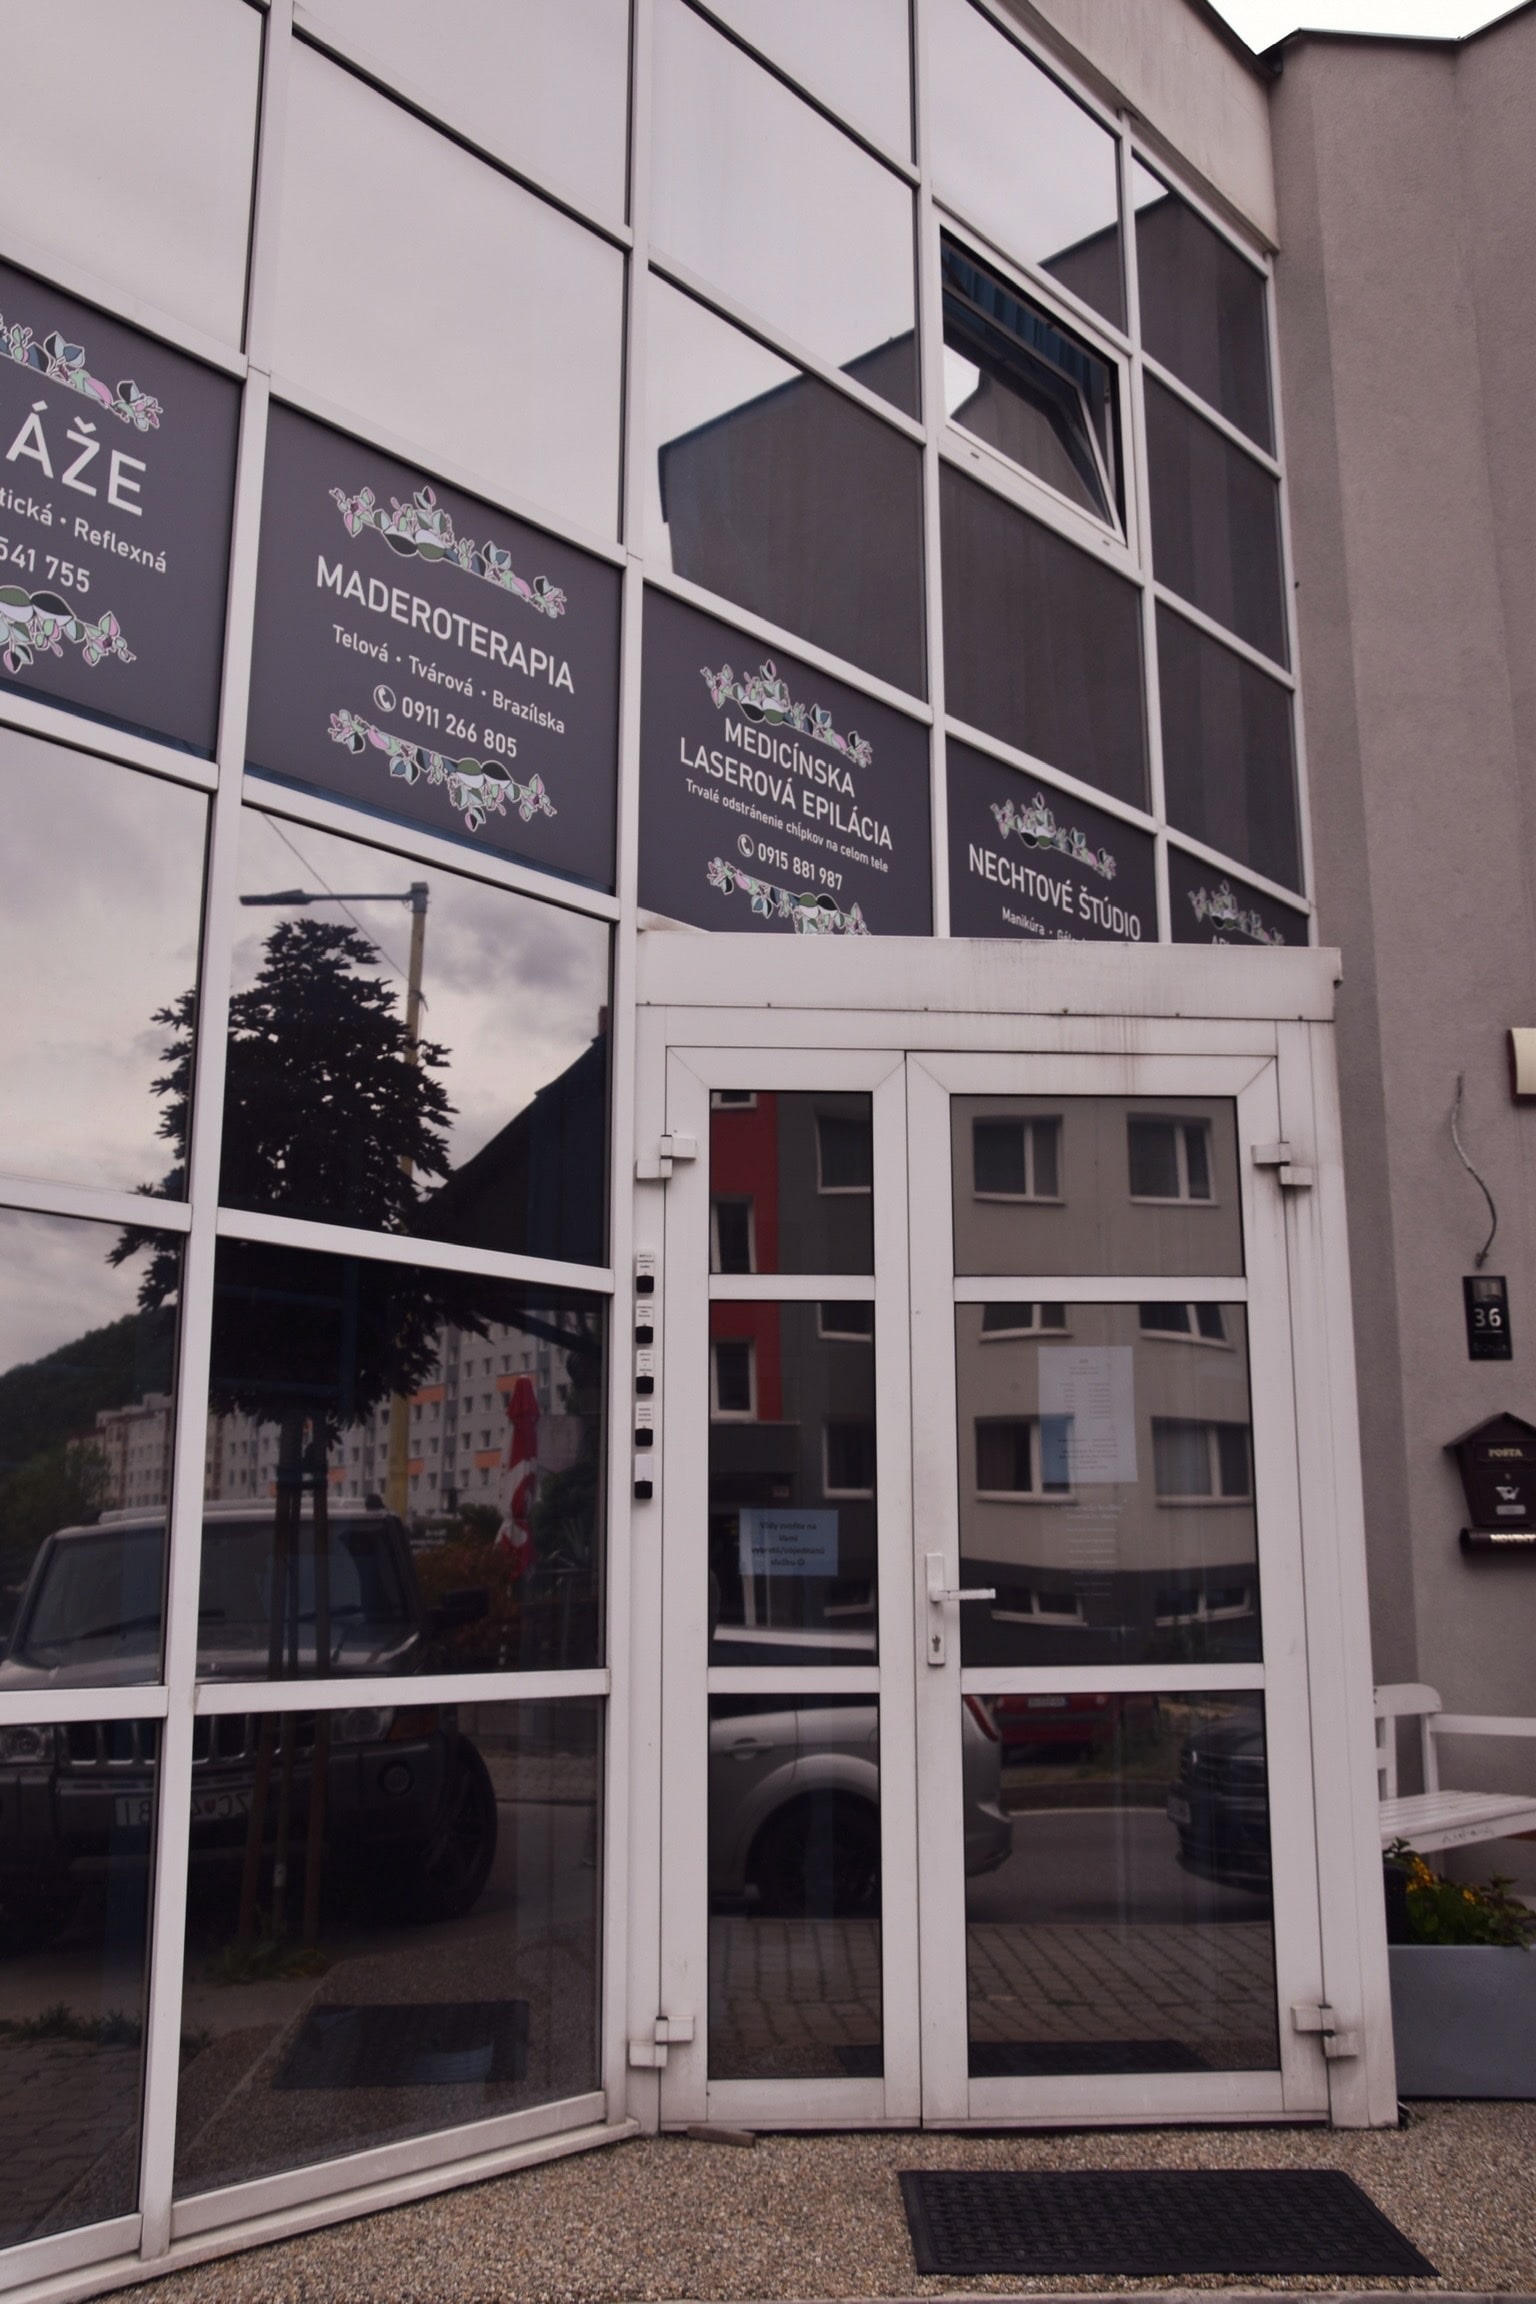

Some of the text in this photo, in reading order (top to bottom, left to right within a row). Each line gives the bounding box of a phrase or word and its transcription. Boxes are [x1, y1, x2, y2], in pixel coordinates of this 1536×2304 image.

[5, 400, 147, 516] ÁŽE
[45, 554, 90, 594] 755
[74, 518, 167, 573] Reflexná
[316, 555, 575, 694] MADEROTERAPIA
[333, 624, 565, 734] Telová Tvárová Brazílska
[402, 696, 517, 757] 0911 266 805
[725, 717, 855, 798] MEDICÍNSKA
[680, 737, 893, 850] LASEROVÁ EPILÁCIA
[686, 778, 720, 804] Trvalé
[722, 796, 784, 830] odstránenie
[826, 838, 838, 851] na
[840, 844, 869, 865] celom
[870, 855, 889, 873] tele
[758, 842, 842, 891] 0915 881 987
[969, 844, 1141, 941] NECHTOVÉ ŠTÚDIO
[1002, 906, 1045, 936] Manikúra
[1474, 1307, 1502, 1328] 36
